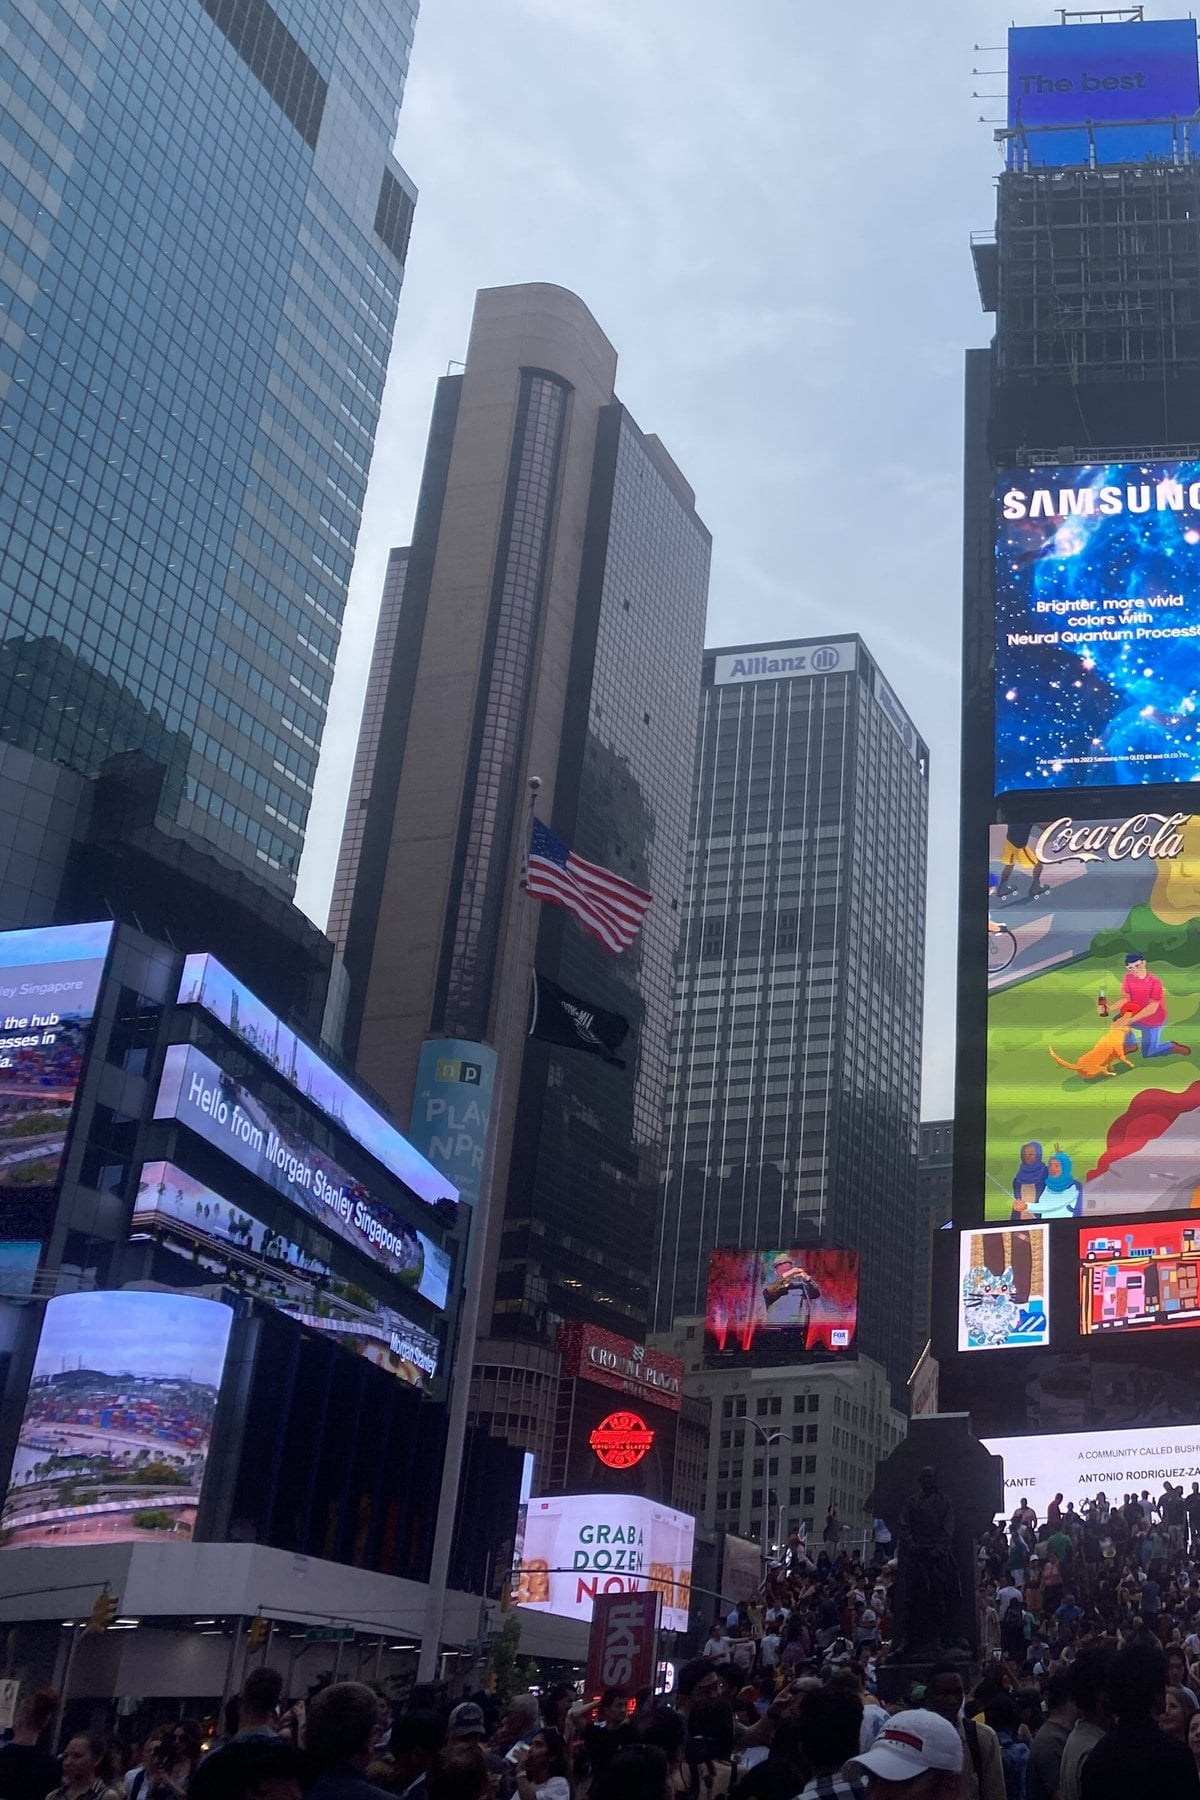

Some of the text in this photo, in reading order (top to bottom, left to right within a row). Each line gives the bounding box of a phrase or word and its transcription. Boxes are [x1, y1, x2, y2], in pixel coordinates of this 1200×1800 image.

[1018, 72, 1147, 94] The best
[1036, 594, 1184, 615] Brighter, more vivid
[1067, 611, 1153, 627] colors with
[1007, 631, 1058, 646] Neural
[1061, 629, 1133, 643] Quantum
[729, 655, 807, 678] Allianz
[1034, 812, 1192, 864] Coca-Cola
[0, 980, 84, 999] ley Singapore
[4, 1012, 60, 1030] the hub
[0, 1032, 56, 1049] esses in
[428, 1133, 485, 1172] NPR
[188, 1072, 402, 1257] Hello from Morgan Stanley Singapore
[590, 1346, 679, 1393] CRON PLAZA
[1078, 1451, 1085, 1460] A
[1085, 1448, 1137, 1460] COMMUNITY
[1139, 1446, 1173, 1456] CALLED
[1078, 1472, 1124, 1484] ANTONIO
[579, 1524, 644, 1546] GRAB A
[573, 1550, 644, 1572] DOZEN
[576, 1576, 640, 1604] NOW
[603, 1601, 645, 1686] tkts
